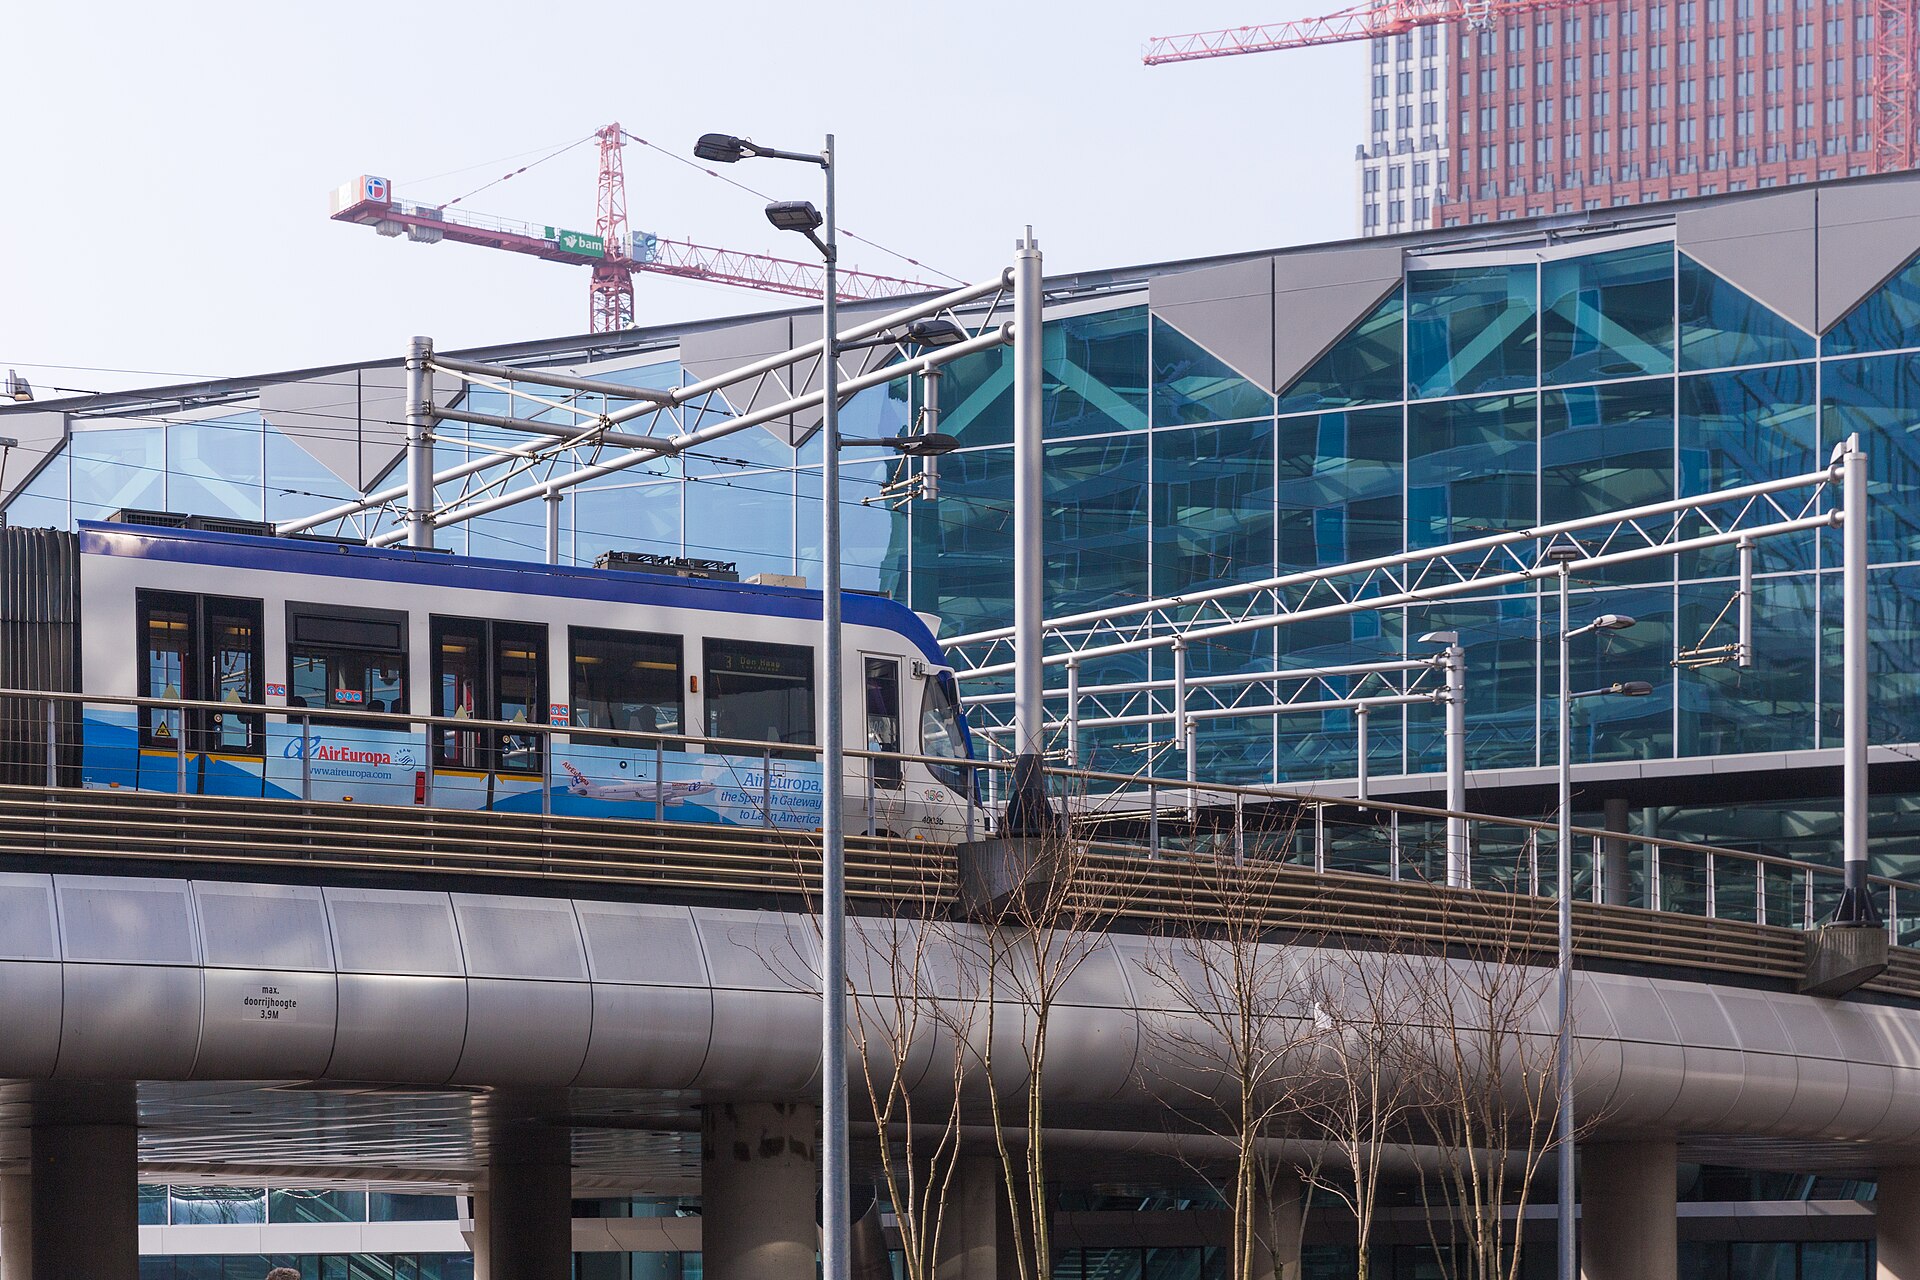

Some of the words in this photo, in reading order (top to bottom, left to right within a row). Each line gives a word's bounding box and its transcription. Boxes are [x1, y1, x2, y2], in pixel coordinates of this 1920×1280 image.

[578, 236, 602, 251] bam
[318, 745, 391, 766] AirEuropa
[743, 772, 764, 787] Air
[721, 791, 737, 802] the
[738, 792, 777, 805] Spanh
[780, 795, 822, 809] Gateway
[740, 809, 750, 819] to
[750, 810, 777, 822] Lan
[778, 811, 821, 824] America
[262, 986, 279, 994] max.
[244, 996, 297, 1009] doorrijhoogte
[260, 1009, 279, 1019] 3,9M
